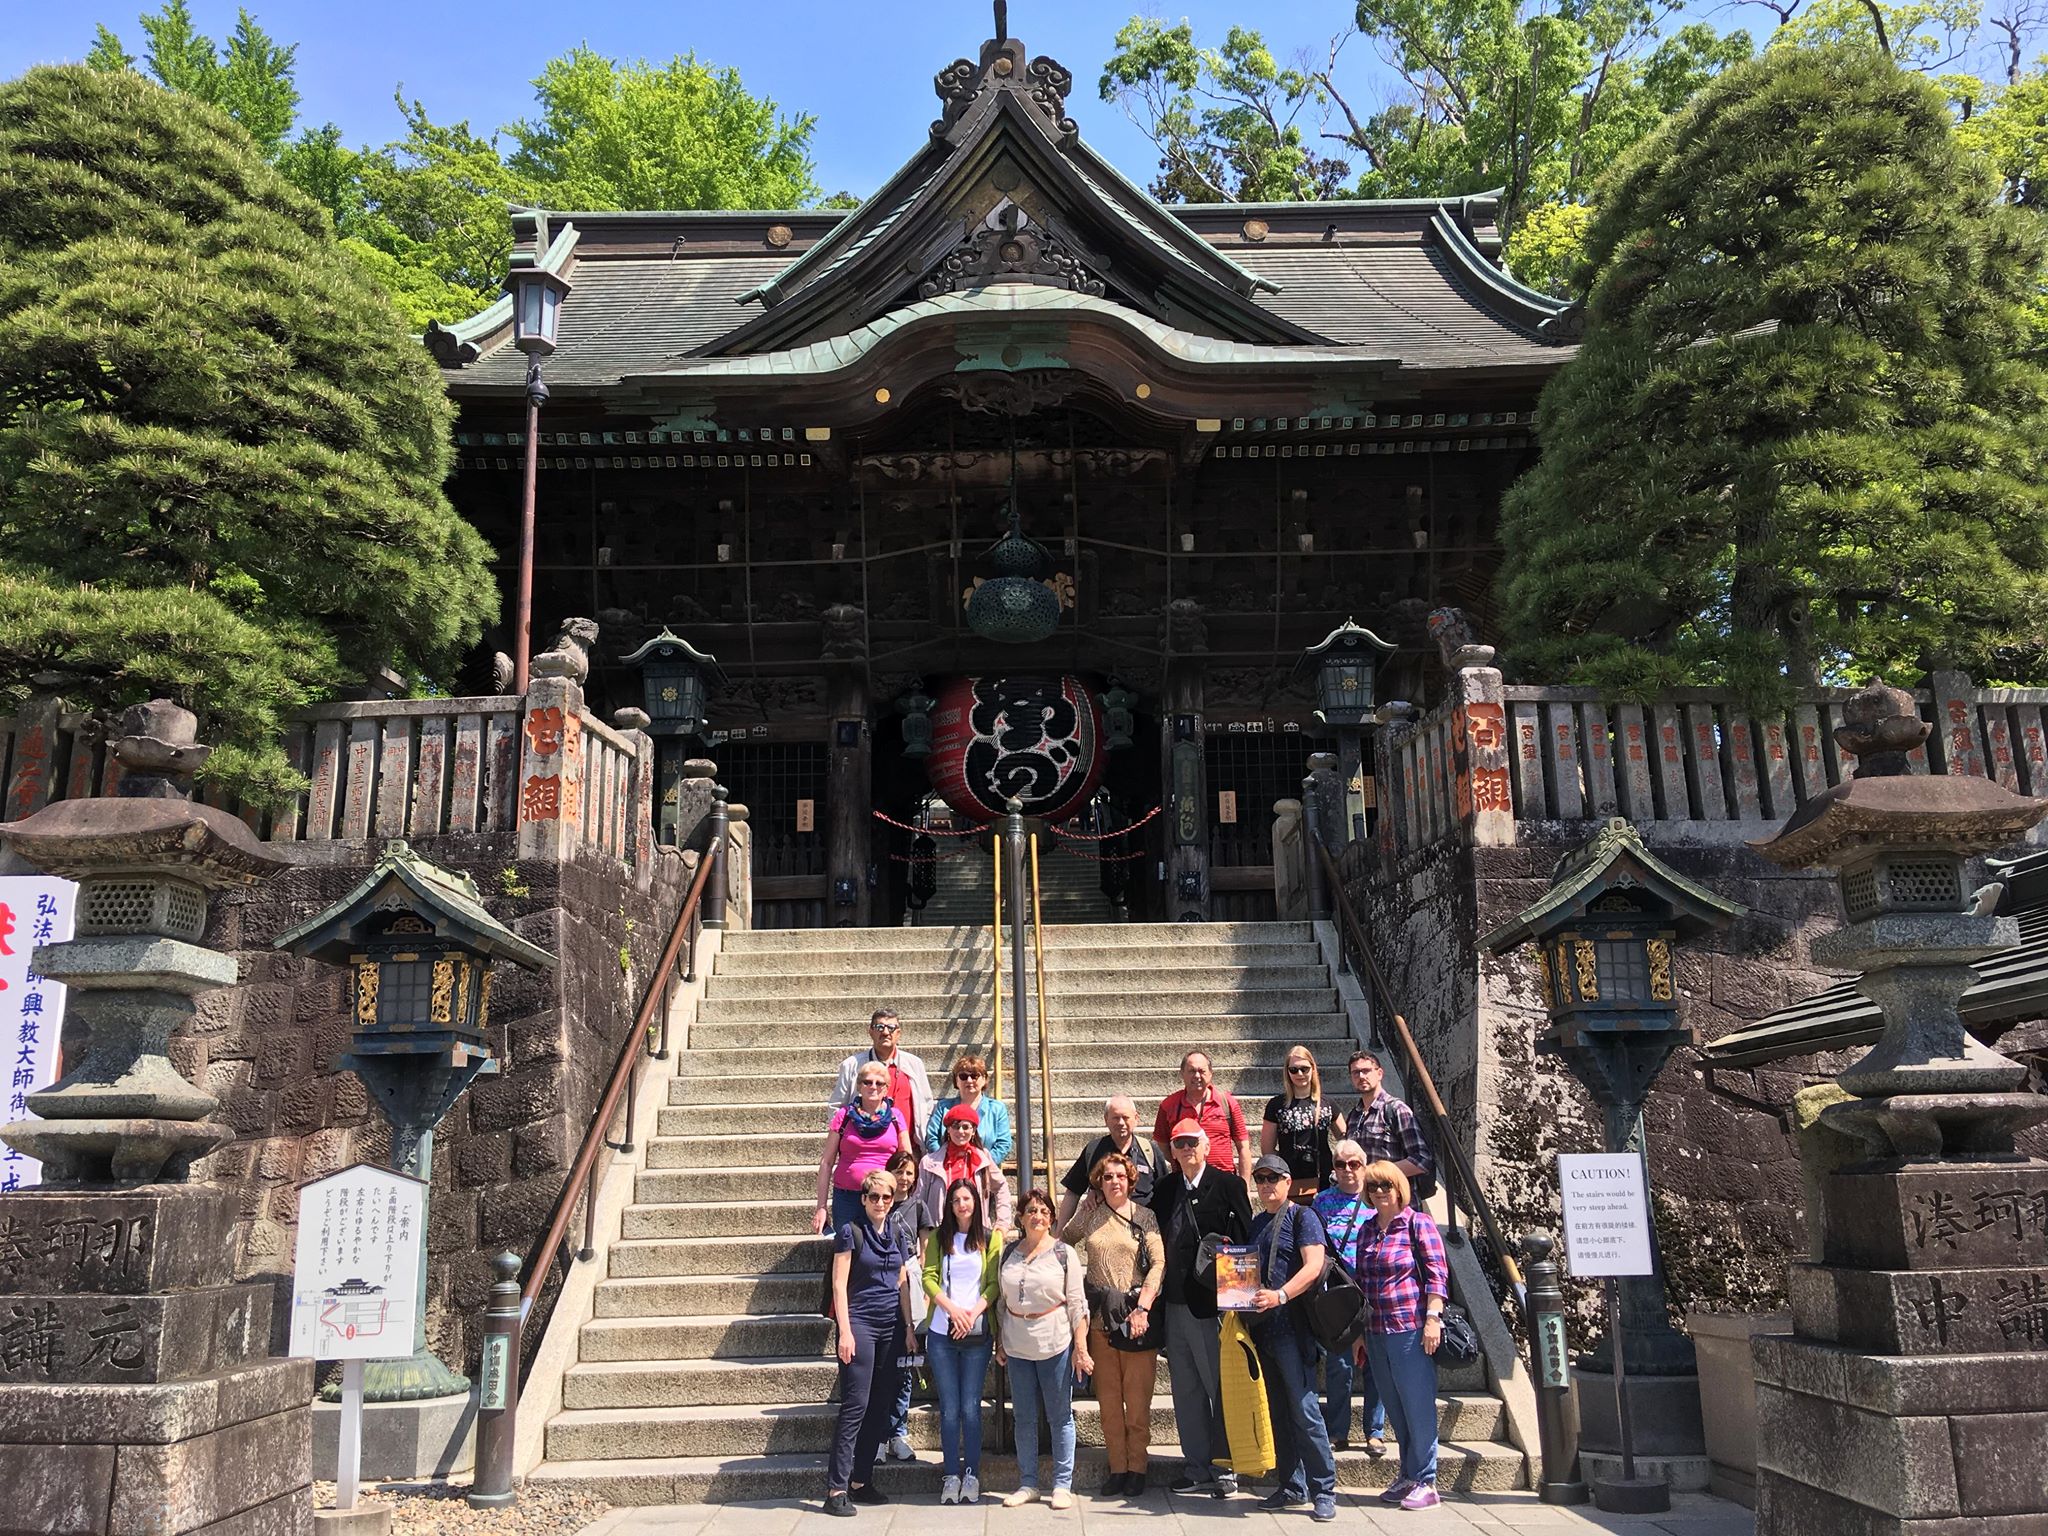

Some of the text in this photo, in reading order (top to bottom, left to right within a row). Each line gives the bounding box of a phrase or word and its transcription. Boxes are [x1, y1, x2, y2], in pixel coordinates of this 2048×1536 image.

[522, 706, 565, 823] せ組
[1467, 702, 1511, 813] 百組
[1571, 1168, 1630, 1180] CAUTION!
[318, 1188, 334, 1276] どうぞご利用下さい
[335, 1188, 349, 1265] 階段がございます
[352, 1187, 366, 1265] 左右にゆるやかな
[370, 1187, 381, 1244] たいへんです
[383, 1186, 398, 1283] 正面階段は上り下りが
[399, 1204, 412, 1241] ご案内
